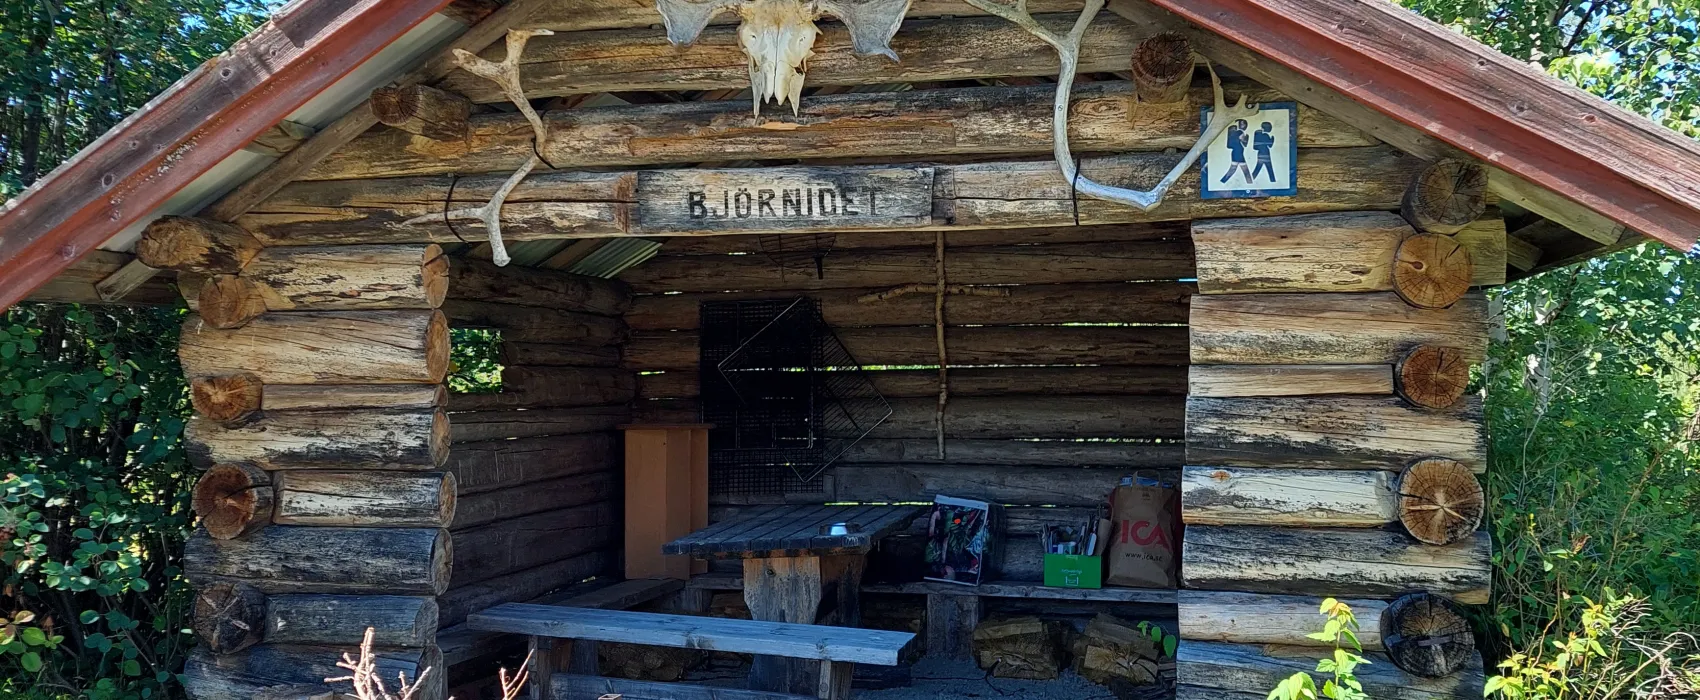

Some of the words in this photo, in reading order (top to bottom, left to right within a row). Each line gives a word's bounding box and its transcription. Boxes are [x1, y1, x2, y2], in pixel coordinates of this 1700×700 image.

[688, 187, 882, 219] BJÖRNIDET
[1121, 520, 1172, 549] ICA
[1125, 552, 1164, 562] www.ica.se
